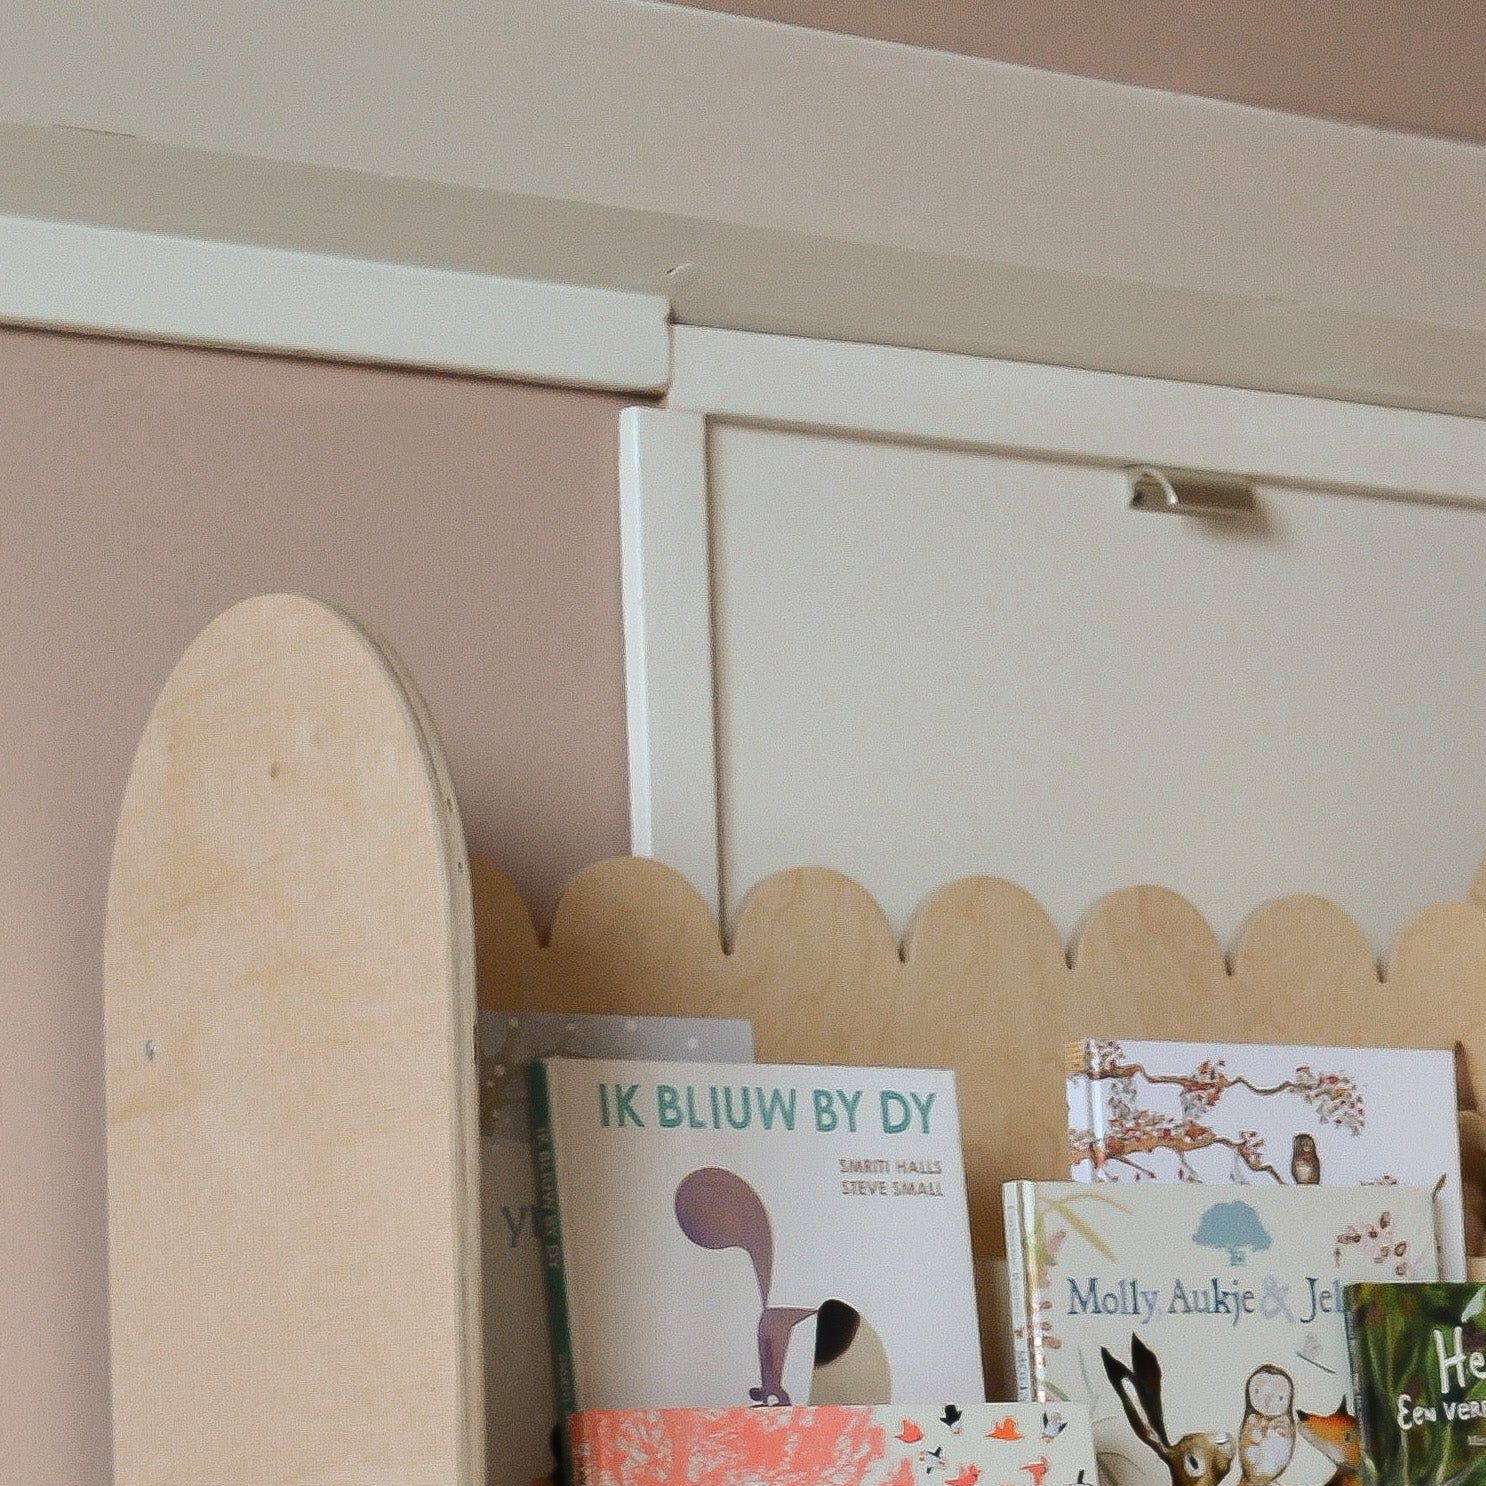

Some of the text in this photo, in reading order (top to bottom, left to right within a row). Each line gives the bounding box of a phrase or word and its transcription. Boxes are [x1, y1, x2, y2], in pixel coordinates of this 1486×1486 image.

[600, 1083, 937, 1134] IK BLIUW BY DY
[896, 1160, 942, 1174] HALLS
[841, 1180, 943, 1196] STEVE SMALL
[1066, 1275, 1344, 1327] Molly Aukje & Jel
[1397, 1393, 1437, 1430] Een
